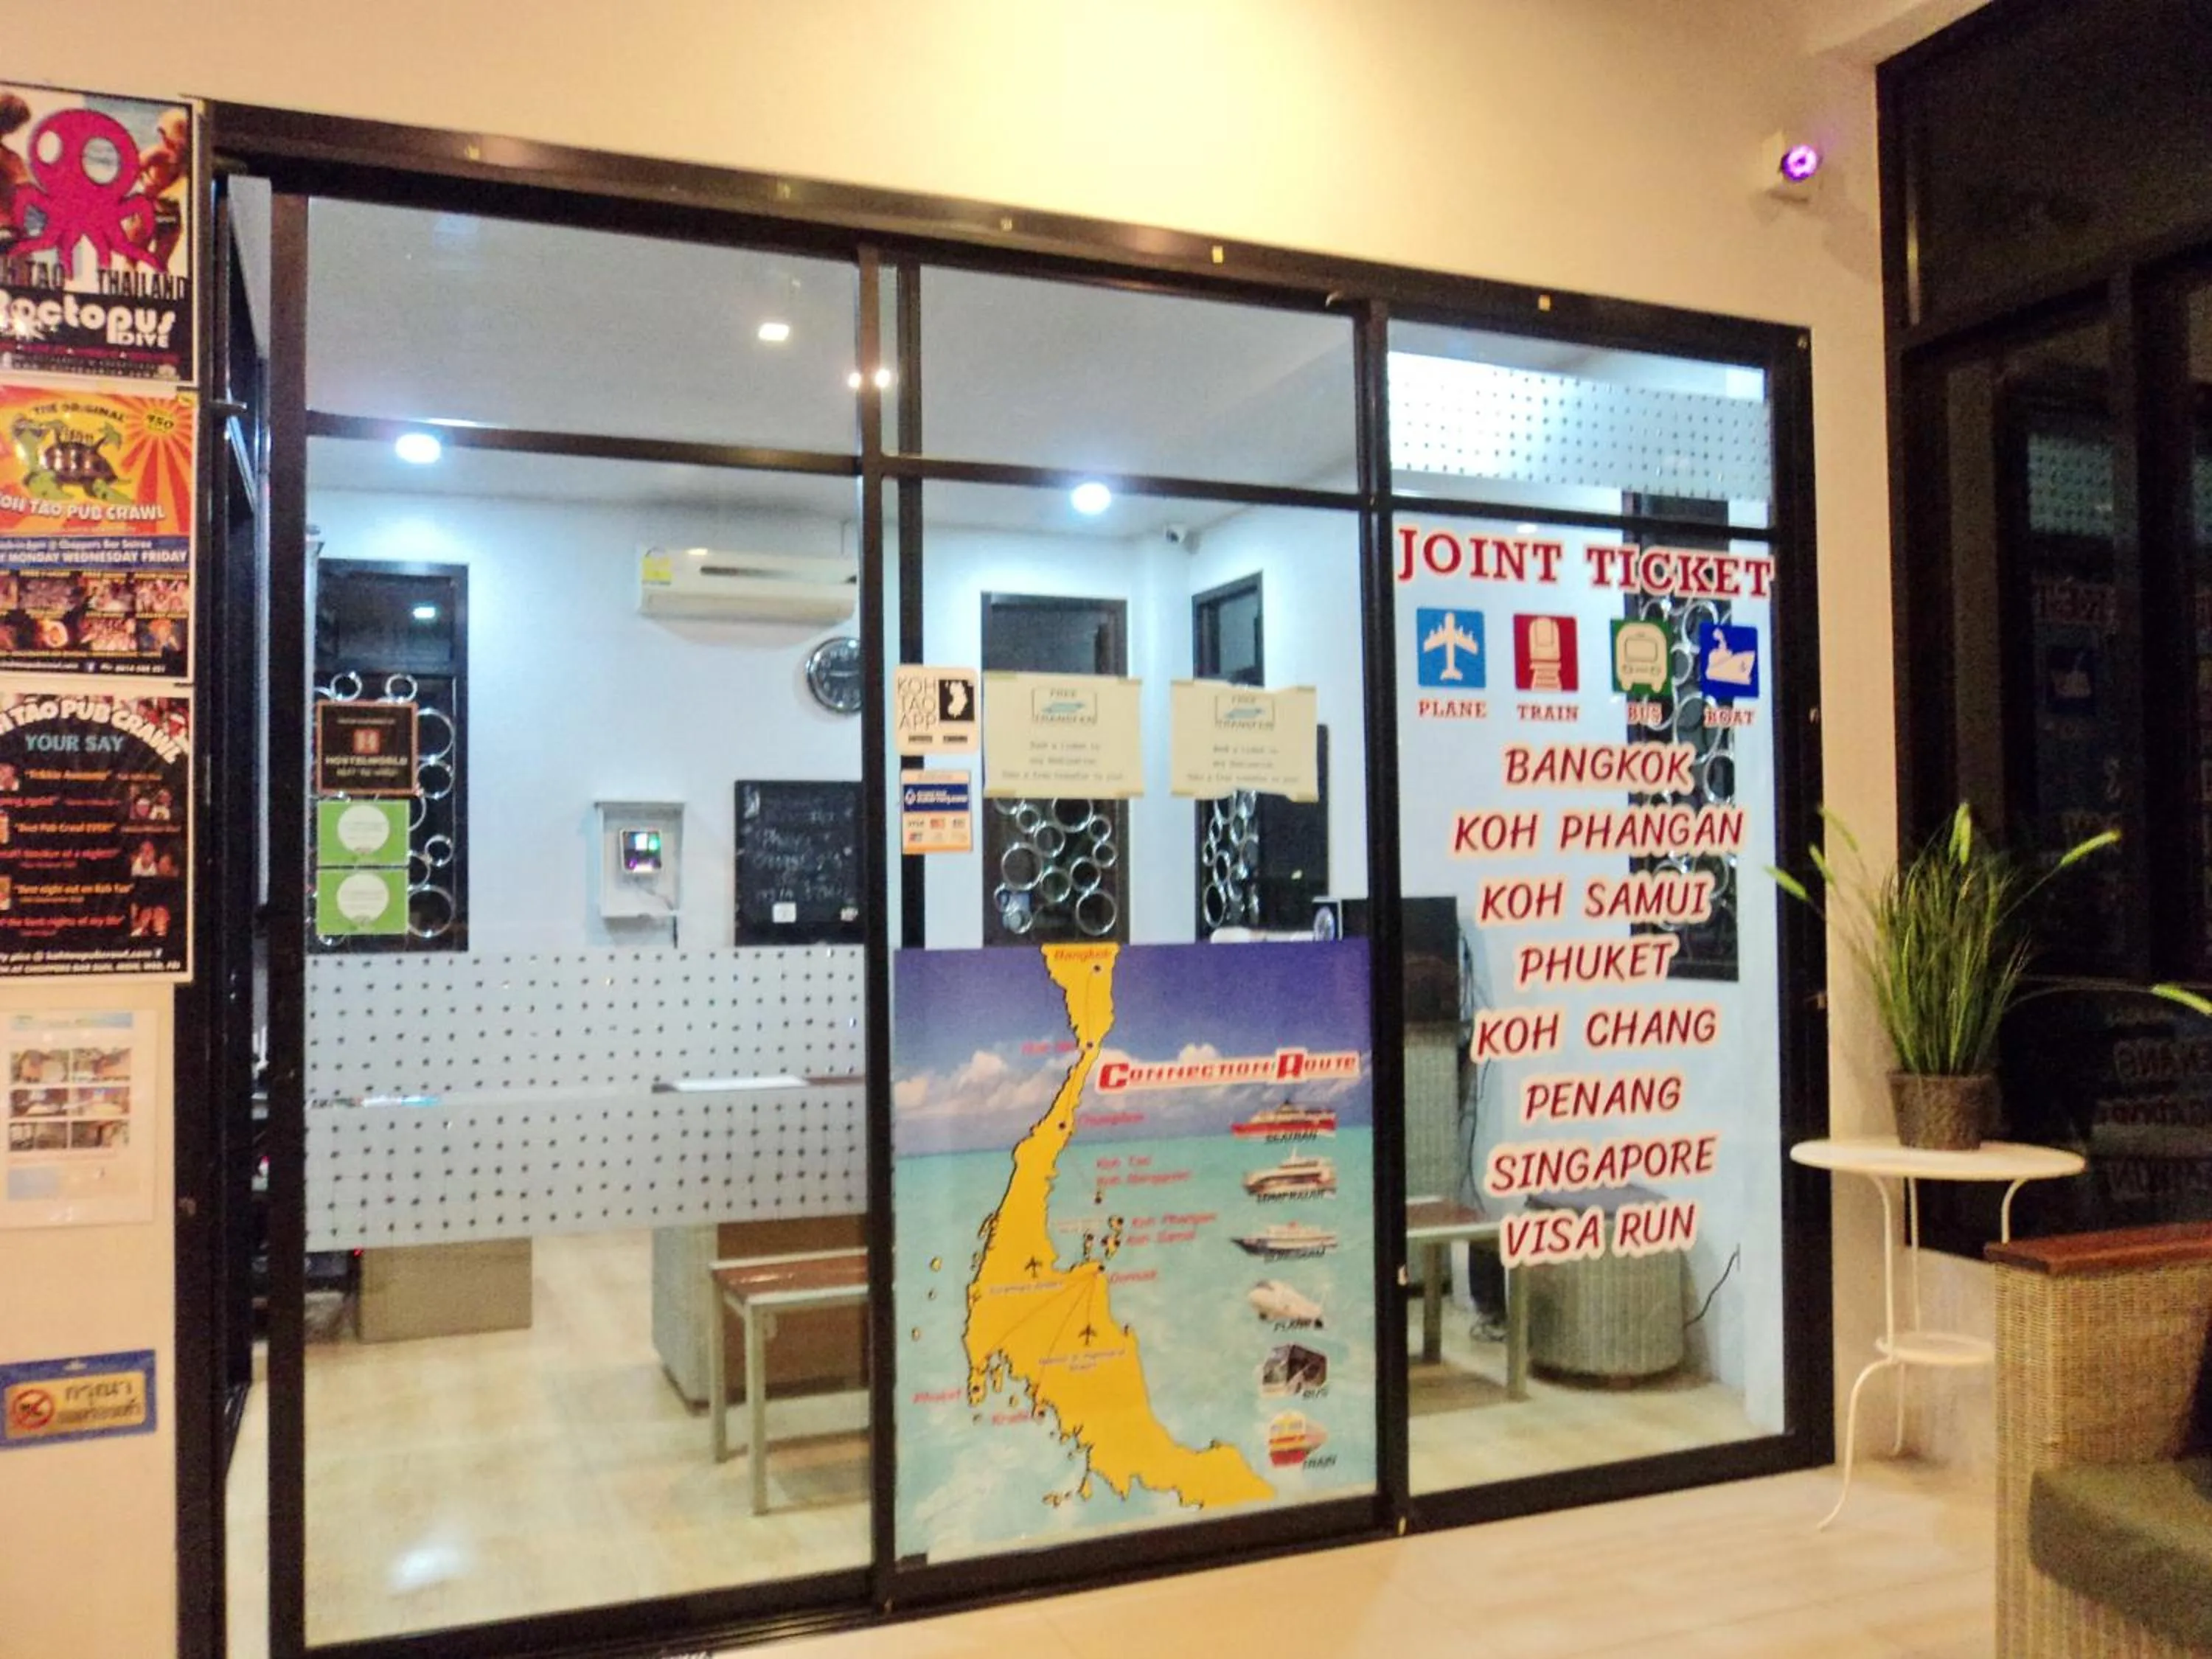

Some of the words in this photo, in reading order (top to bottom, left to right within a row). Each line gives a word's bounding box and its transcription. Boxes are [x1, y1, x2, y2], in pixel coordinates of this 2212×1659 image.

[117, 333, 170, 349] DIVE
[60, 403, 126, 422] ORIGINAL
[0, 492, 26, 512] OH
[29, 499, 63, 517] TAO
[68, 504, 102, 521] PUB
[106, 504, 166, 521] CRAWL
[9, 551, 60, 563] MONDAY
[62, 551, 139, 563] WEDNESDAY
[142, 550, 188, 563] FRIDAY
[1397, 526, 1564, 582] JOINT
[1585, 543, 1775, 598] TICKET
[897, 676, 937, 696] KOH
[897, 695, 937, 712] TAO
[1416, 698, 1488, 720] PLANE
[1517, 702, 1580, 723] TRAIN
[1626, 701, 1663, 726] BUS
[1704, 705, 1756, 728] BOAT
[10, 700, 60, 726] TAO
[60, 699, 111, 724] PUB
[111, 709, 182, 765] CRAWL
[897, 712, 938, 731] APP
[24, 734, 80, 751] YOUR
[84, 735, 125, 752] SAY
[1503, 745, 1694, 787] BANGKOK
[1453, 811, 1540, 853] KOH
[1558, 809, 1746, 852] PHANGAN
[1479, 879, 1565, 922] KOH
[1583, 879, 1712, 918] SAMUI
[1517, 939, 1677, 985] PHUKET
[1475, 1010, 1561, 1057] KOH
[1585, 1007, 1719, 1048] CHANG
[1523, 1074, 1684, 1121] PENANG
[1489, 1135, 1719, 1193] SINGAPORE
[1504, 1211, 1601, 1259] VISA
[1618, 1201, 1697, 1251] RUN
